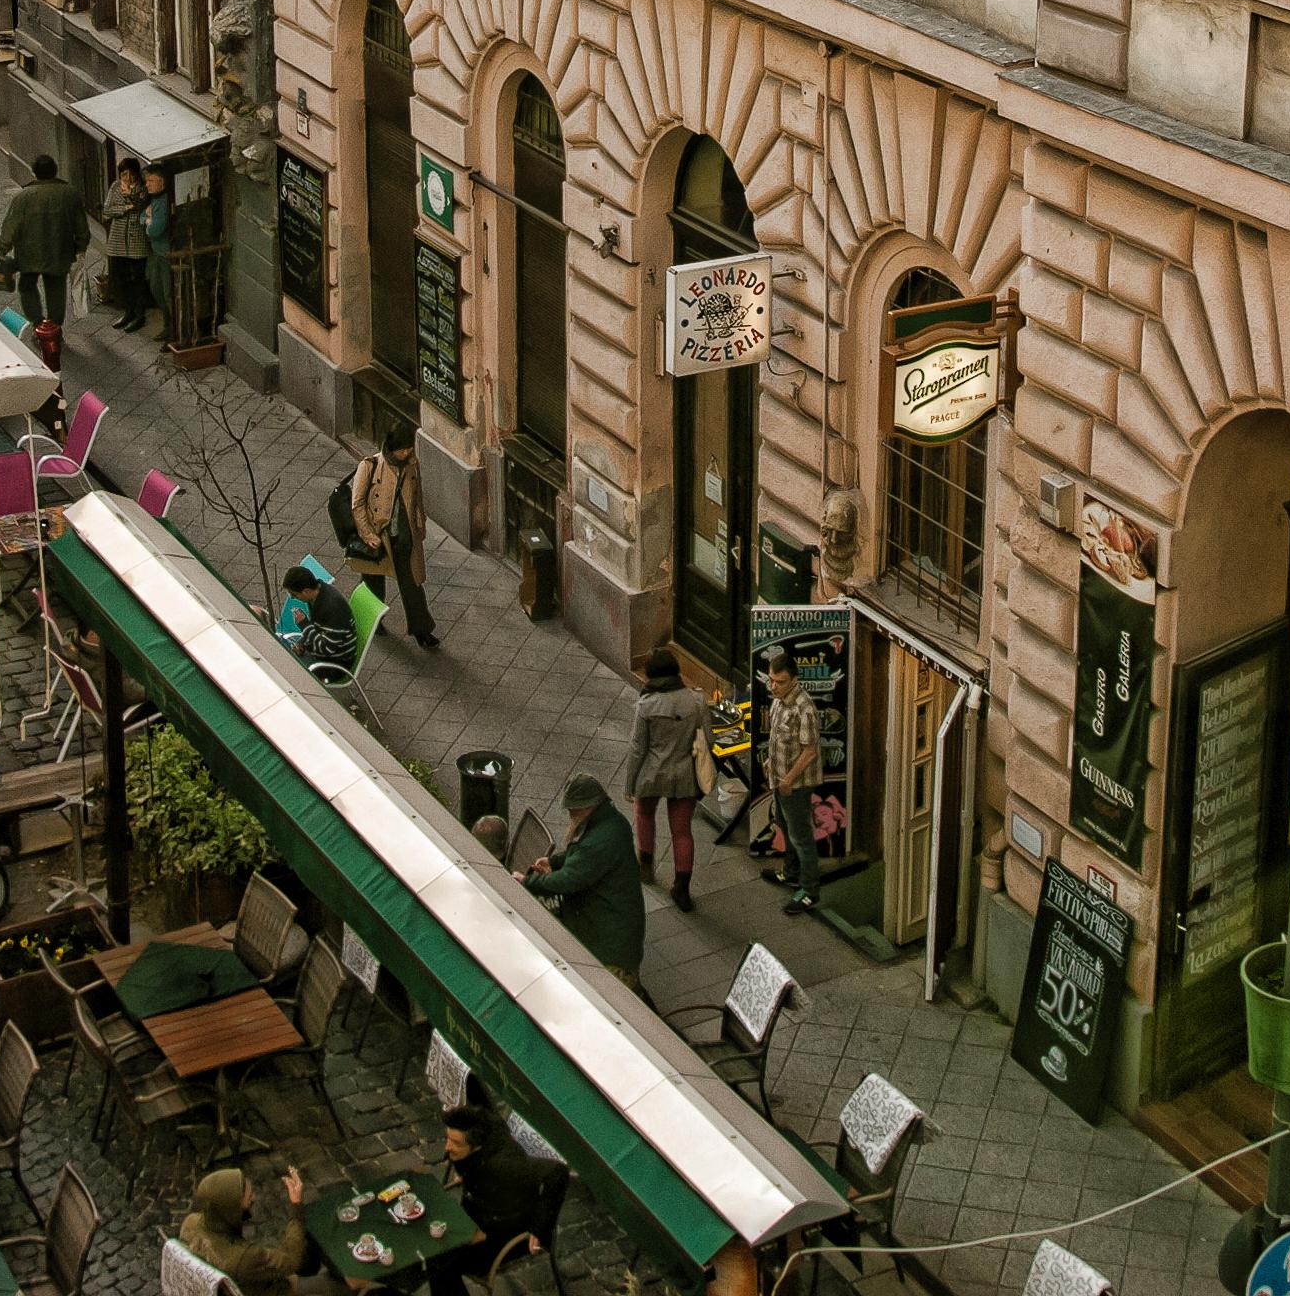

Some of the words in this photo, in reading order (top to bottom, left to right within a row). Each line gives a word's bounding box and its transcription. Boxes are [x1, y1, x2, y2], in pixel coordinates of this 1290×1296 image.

[679, 267, 765, 308] LEONARDO
[680, 328, 765, 362] PIZZÉRIA
[902, 355, 990, 406] Staropramen
[930, 411, 961, 424] PRAGUE
[753, 611, 822, 622] LEONARDO
[1116, 630, 1131, 702] GALÉRIA
[1092, 667, 1106, 737] GASTRO
[1080, 757, 1134, 809] GUINNESS
[1089, 910, 1109, 941] PUB
[1040, 964, 1094, 1036] 50%
